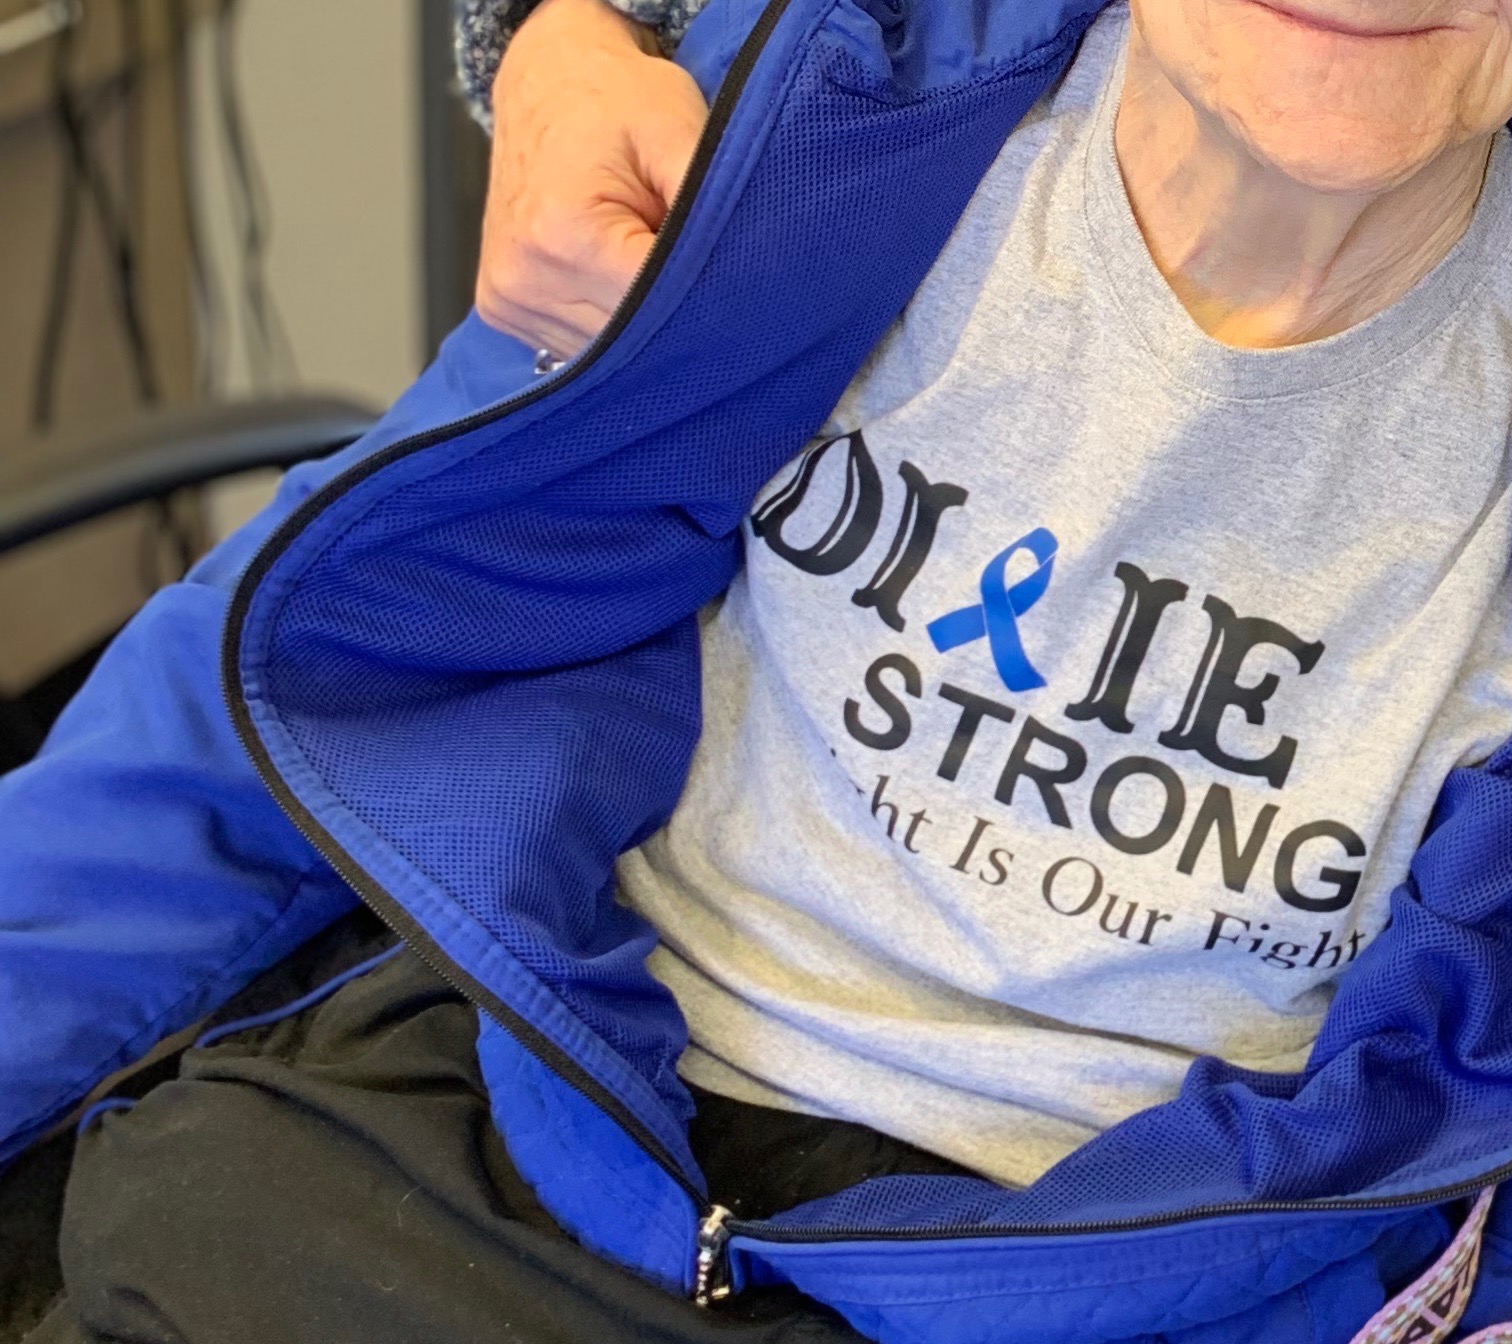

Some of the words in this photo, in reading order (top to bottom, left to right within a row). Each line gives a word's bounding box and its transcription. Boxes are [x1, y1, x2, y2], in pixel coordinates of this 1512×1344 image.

[843, 652, 1367, 913] STRONG
[949, 815, 1015, 886] Is
[1042, 856, 1173, 945] Our
